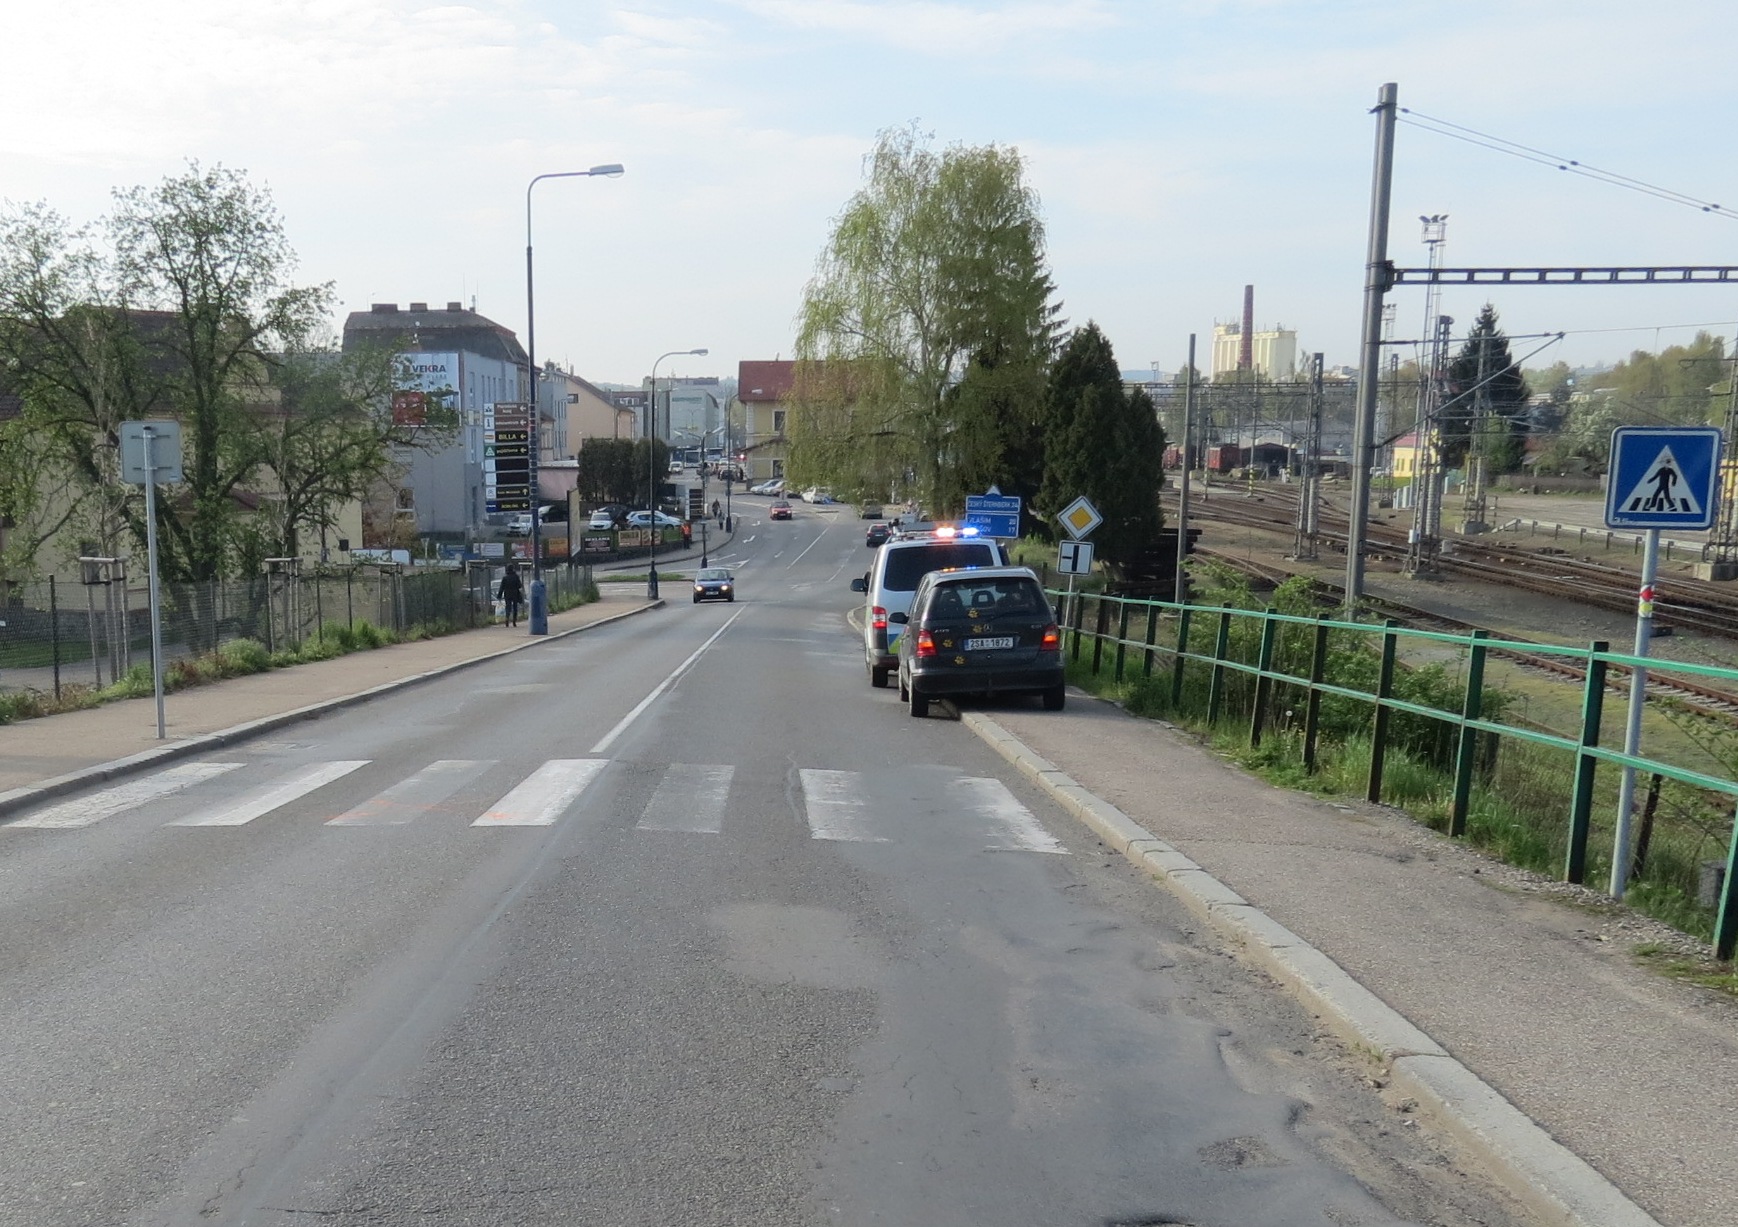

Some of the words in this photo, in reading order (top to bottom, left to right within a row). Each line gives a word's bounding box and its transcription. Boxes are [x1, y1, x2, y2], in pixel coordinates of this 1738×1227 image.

[412, 364, 446, 373] VEKRA
[970, 639, 984, 648] 2SA
[992, 638, 1010, 647] 1872
